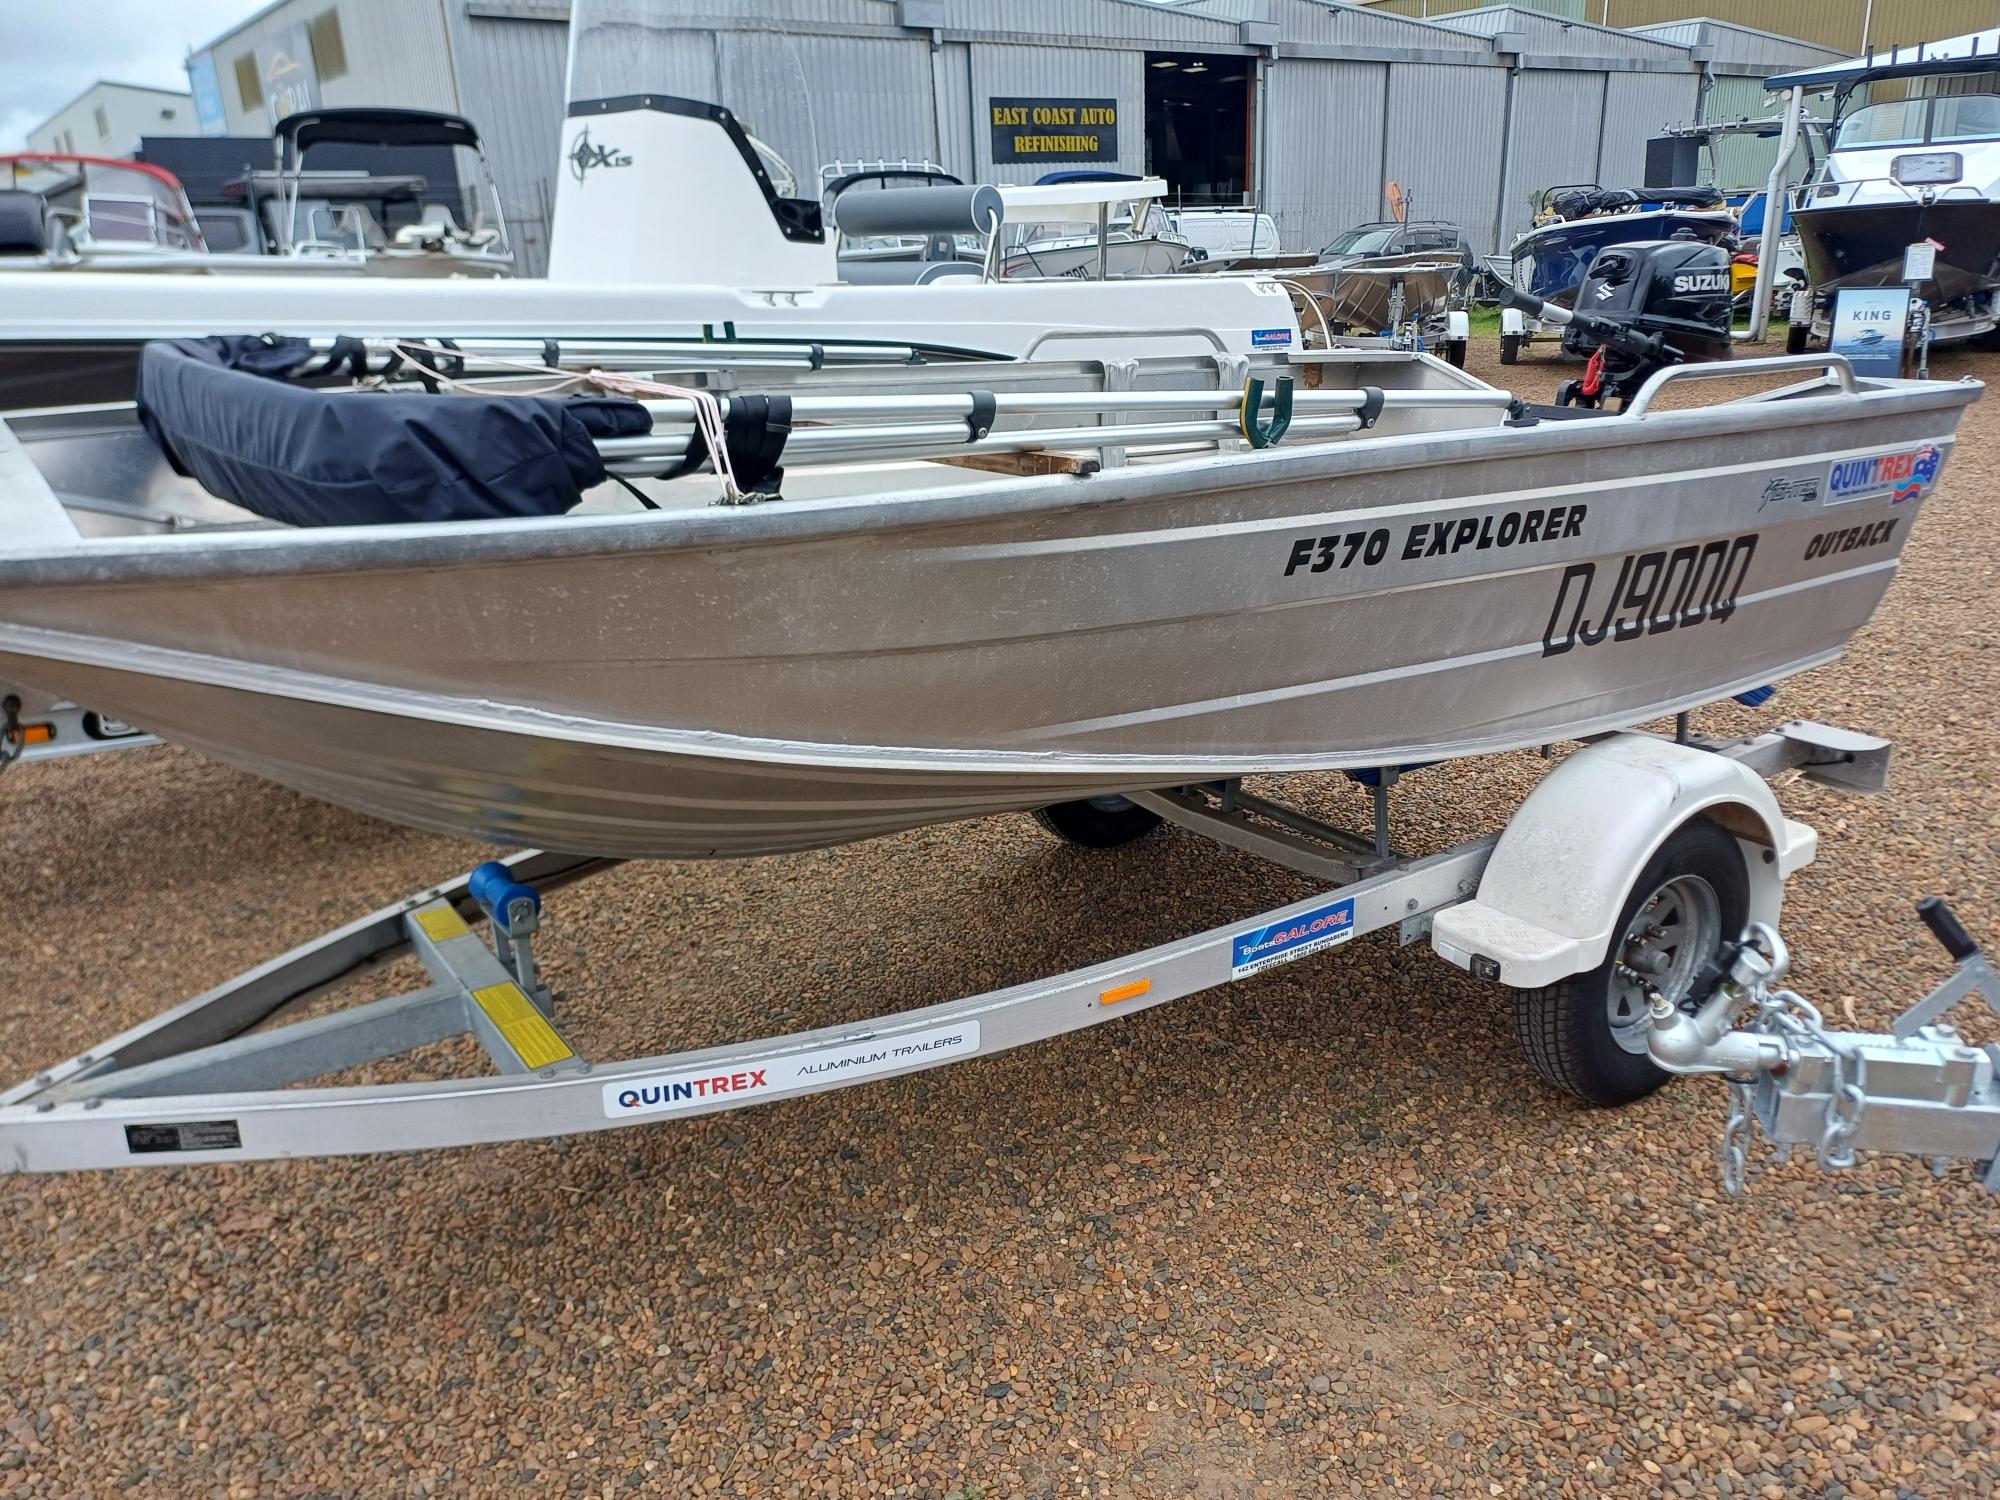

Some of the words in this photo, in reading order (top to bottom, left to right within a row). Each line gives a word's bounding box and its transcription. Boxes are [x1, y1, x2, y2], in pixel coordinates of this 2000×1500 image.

[993, 107, 1028, 125] EAST
[1032, 107, 1076, 125] COAST
[1080, 107, 1116, 125] AUTO
[1014, 135, 1099, 152] REFINISHING
[1853, 310, 1892, 321] KING
[1830, 453, 1915, 491] QUINTREX
[1284, 528, 1391, 577] F370
[1401, 504, 1588, 561] EXPLORER
[1804, 518, 1899, 560] OUTBACK
[1250, 952, 1288, 970] ENTERPRISE
[1289, 942, 1312, 956] STREET
[1313, 930, 1349, 947] BUNDABERG
[618, 1069, 768, 1108] QUINTREX
[797, 1051, 887, 1077] ALUMINIUM
[892, 1034, 964, 1058] TRAILERS
